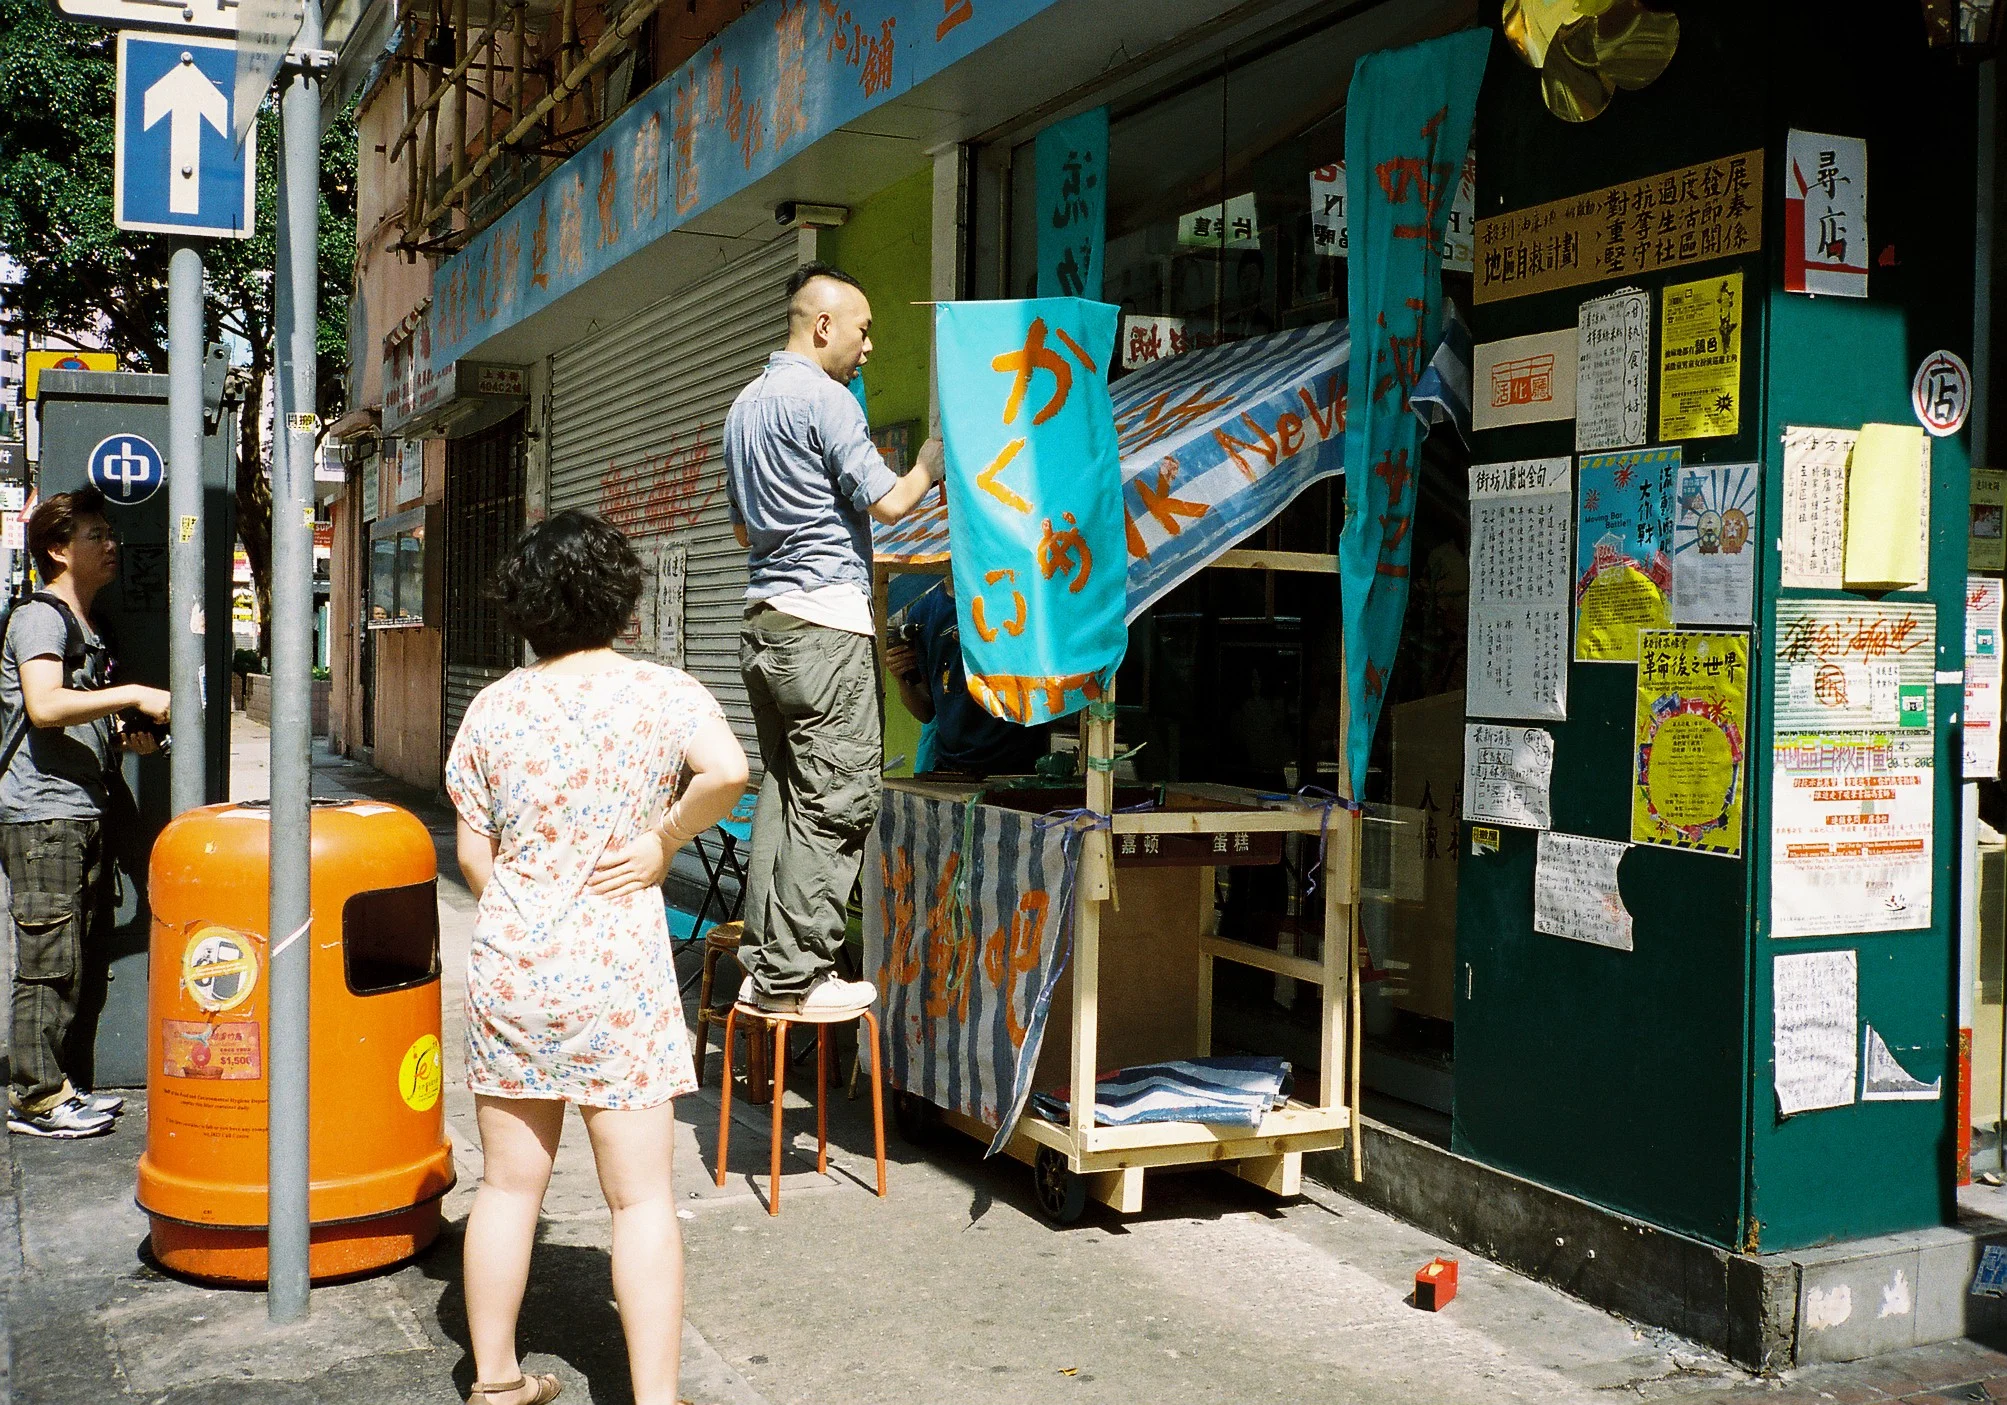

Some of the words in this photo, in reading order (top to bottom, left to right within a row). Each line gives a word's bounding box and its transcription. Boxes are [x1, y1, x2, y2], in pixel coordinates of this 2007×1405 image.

[1604, 158, 1752, 220] 對抗過度發展
[1817, 150, 1851, 263] 尋店
[1606, 193, 1753, 245] 重奪生活節奏
[1483, 231, 1580, 287] 地區自救計劃
[1604, 222, 1751, 275] 堅守社區關係
[1496, 375, 1550, 405] 活化廳
[1925, 352, 1959, 422] 店
[1643, 651, 1742, 684] 革命後之世界
